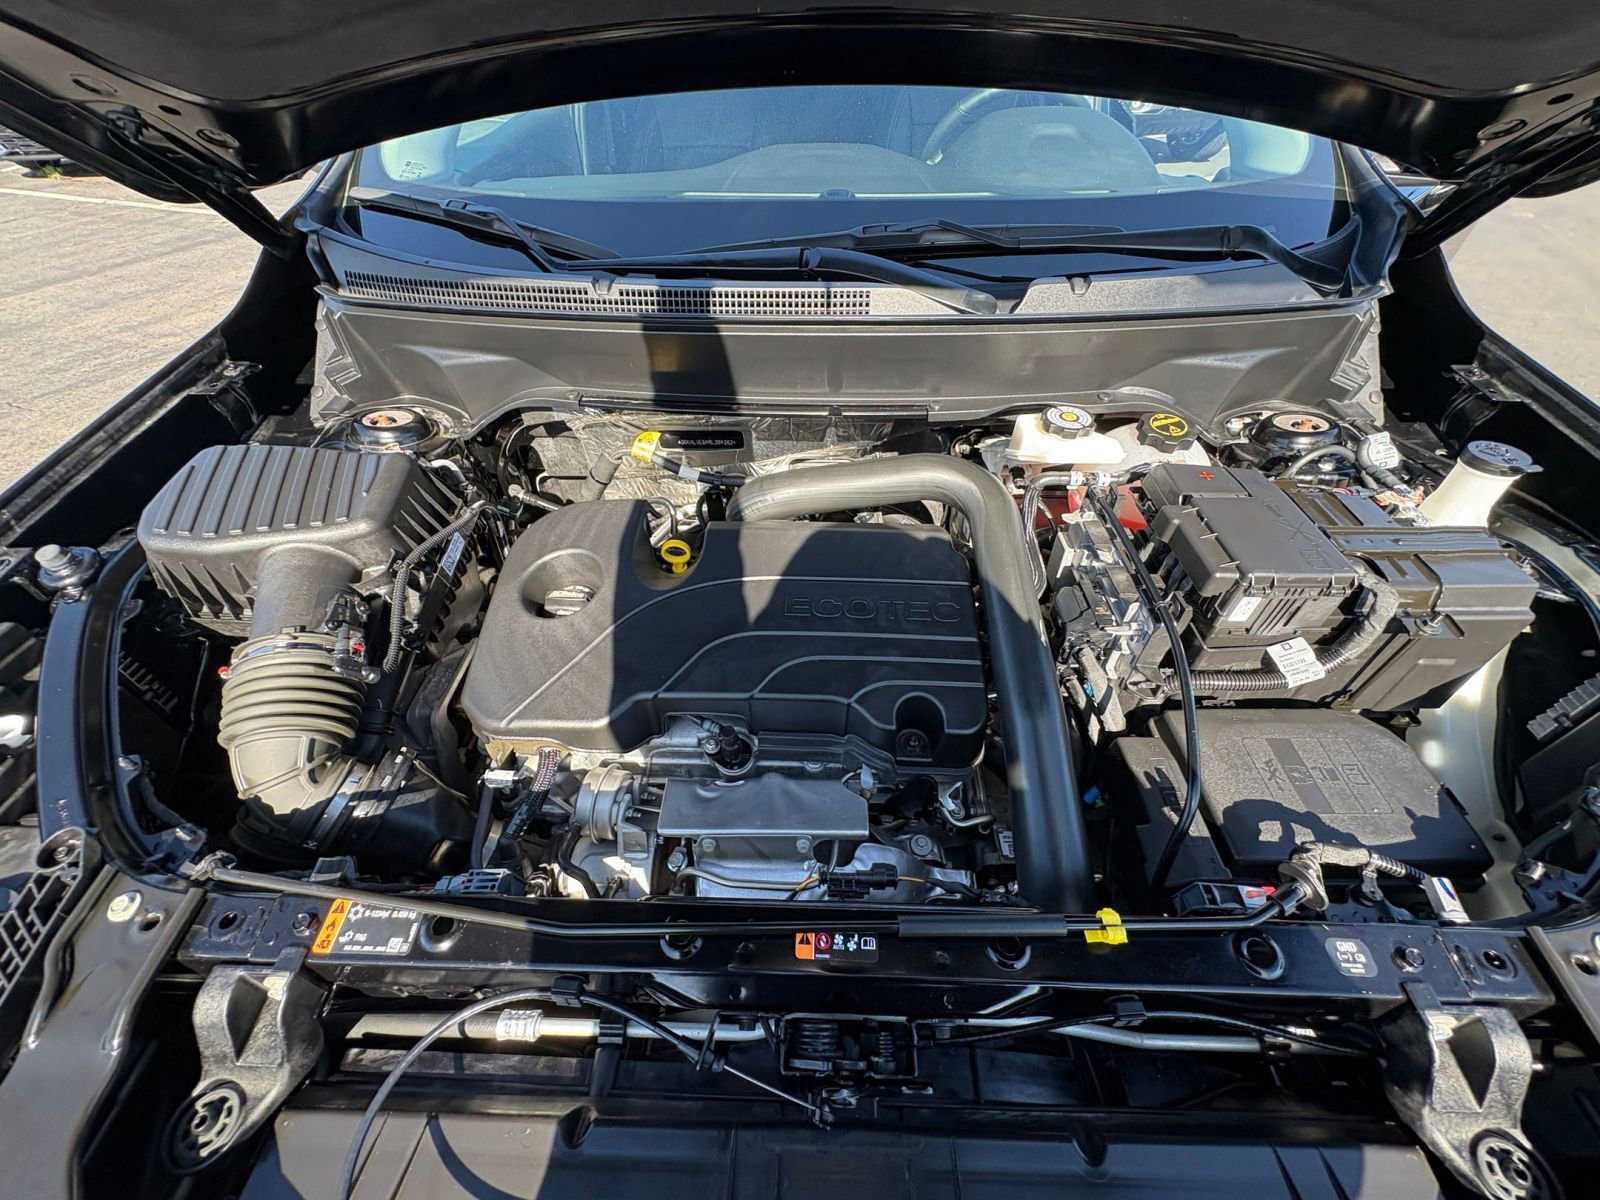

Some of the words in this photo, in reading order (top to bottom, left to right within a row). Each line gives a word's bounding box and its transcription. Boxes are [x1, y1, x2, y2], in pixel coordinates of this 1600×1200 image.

[784, 598, 961, 622] ECOTEC
[354, 933, 367, 941] PAG
[1336, 941, 1356, 952] GND
